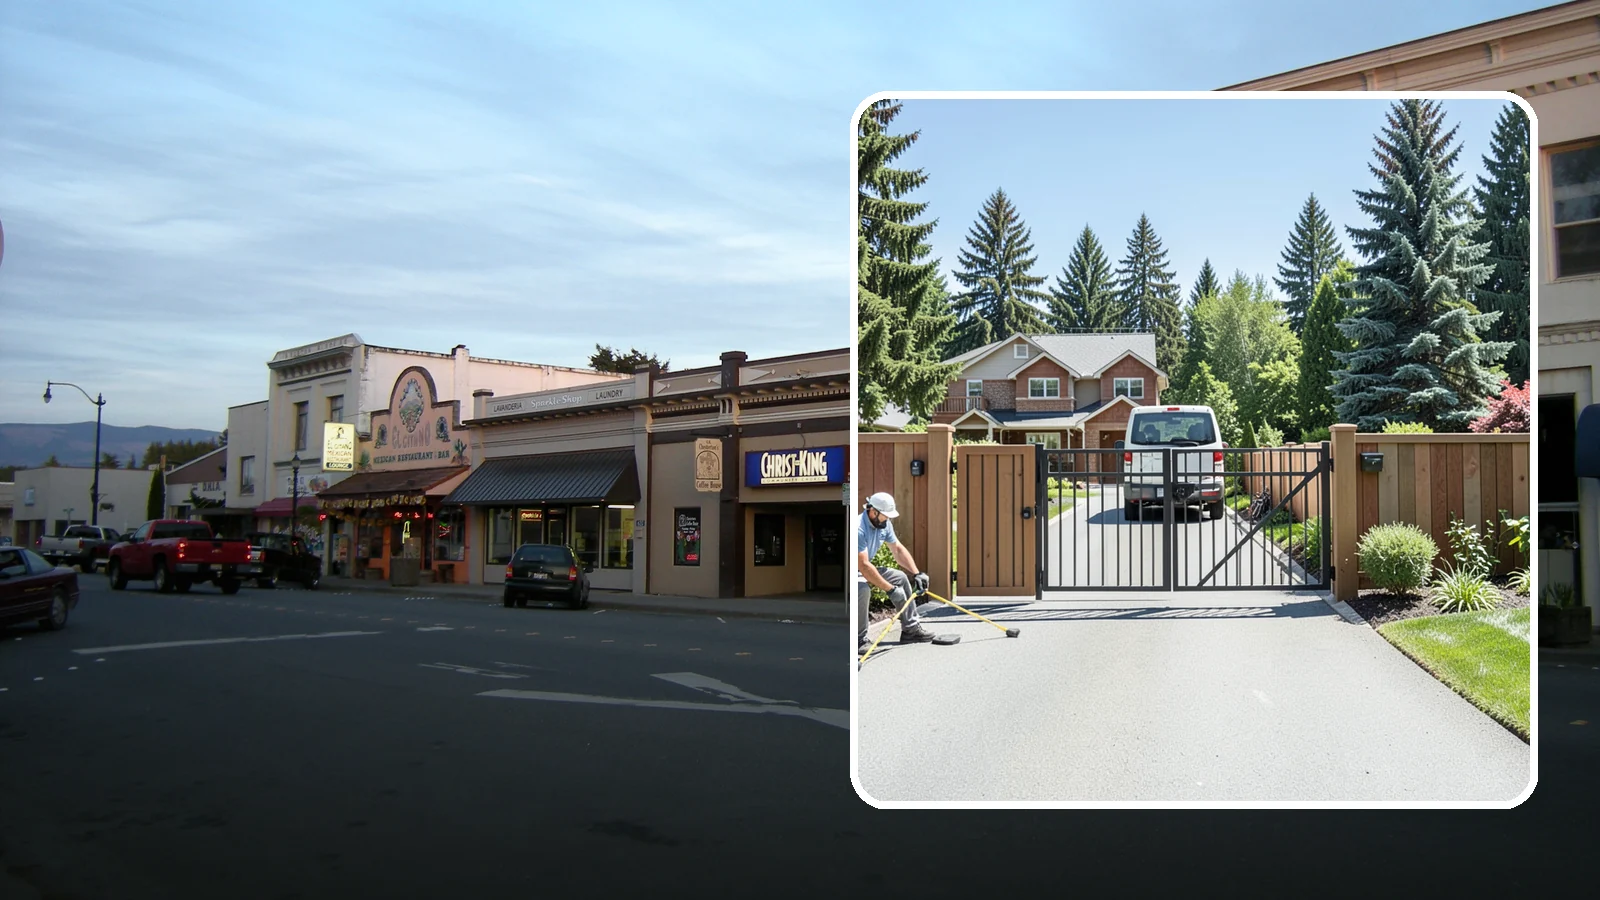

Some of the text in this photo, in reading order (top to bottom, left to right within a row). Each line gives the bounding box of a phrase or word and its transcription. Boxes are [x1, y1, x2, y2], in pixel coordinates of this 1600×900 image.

[531, 394, 582, 410] Sparkle Shop
[595, 389, 624, 400] LAUNDRY
[493, 402, 522, 413] LAVANDERIA
[374, 449, 450, 464] MEXICAN RESTAURANT BAR
[761, 450, 827, 478] CHRIST KING
